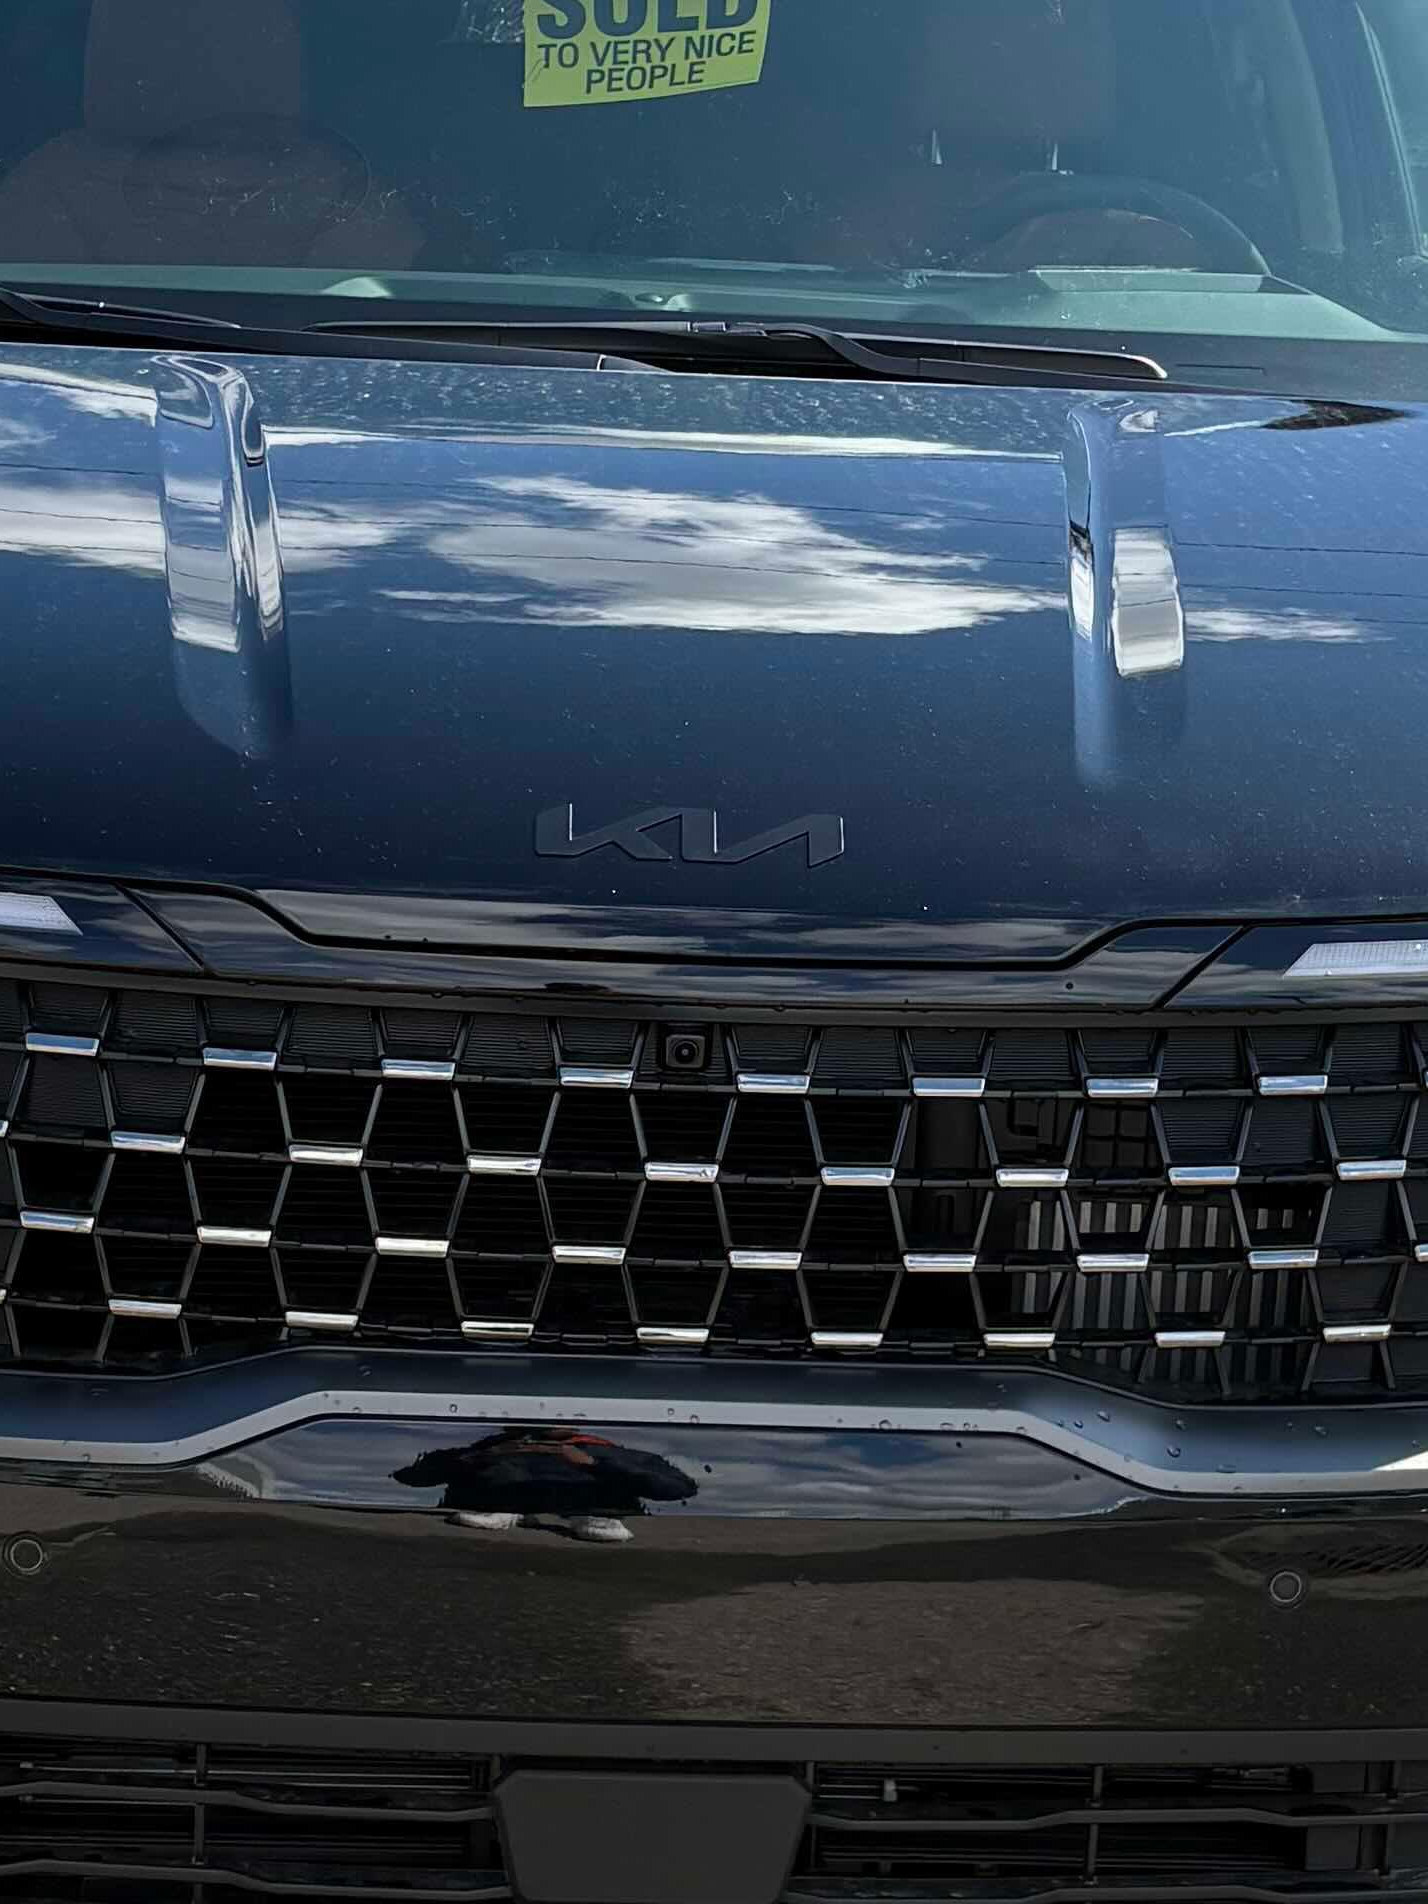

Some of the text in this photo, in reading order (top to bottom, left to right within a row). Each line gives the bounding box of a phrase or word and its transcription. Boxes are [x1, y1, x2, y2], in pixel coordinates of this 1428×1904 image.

[537, 30, 757, 69] TO VERY NICE
[585, 60, 706, 94] PEOPLE
